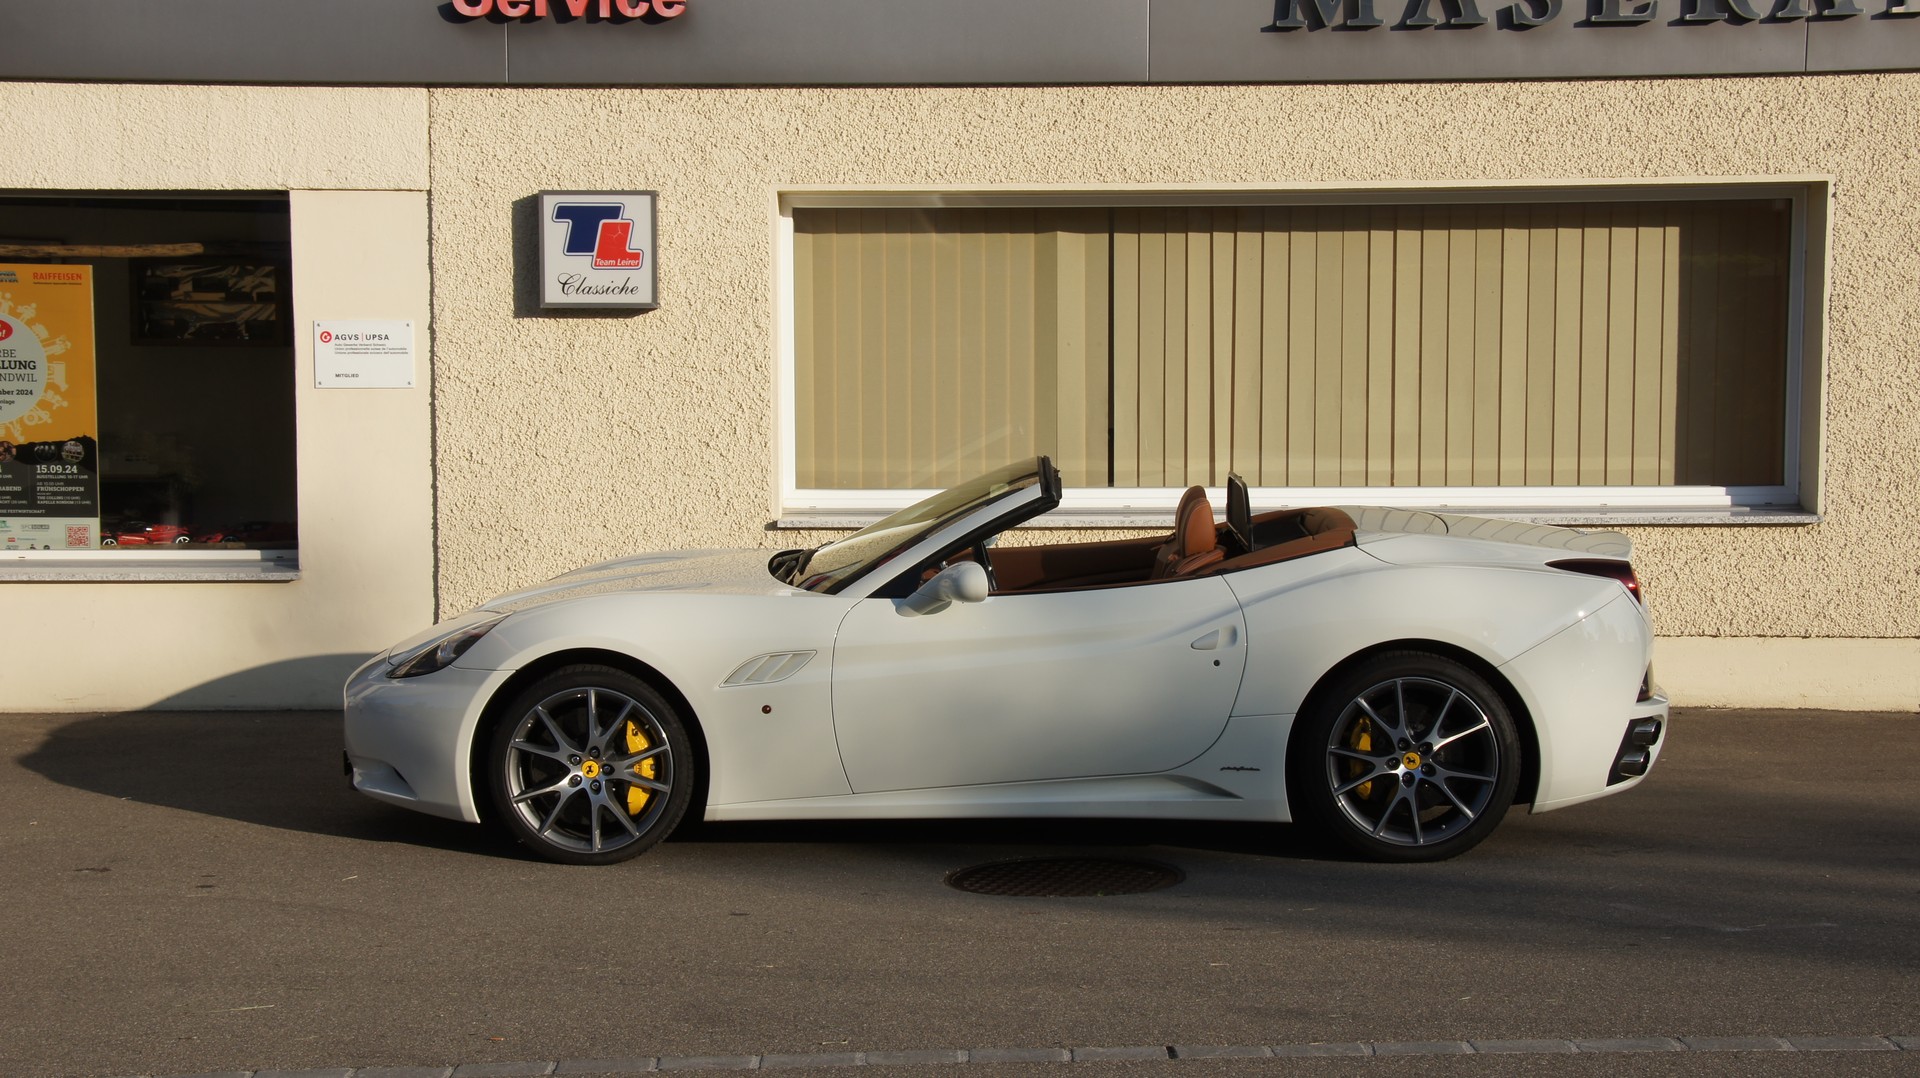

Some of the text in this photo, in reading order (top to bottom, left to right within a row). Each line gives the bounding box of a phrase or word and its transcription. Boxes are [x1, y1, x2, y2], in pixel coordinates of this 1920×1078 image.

[596, 258, 640, 266] Team Leirer
[33, 272, 82, 280] RAIFFEISEN
[557, 272, 639, 297] Classiche
[334, 333, 390, 341] AGVS UPSA
[0, 349, 16, 358] BE
[0, 360, 36, 370] LUNG
[36, 465, 78, 473] 15.09.24
